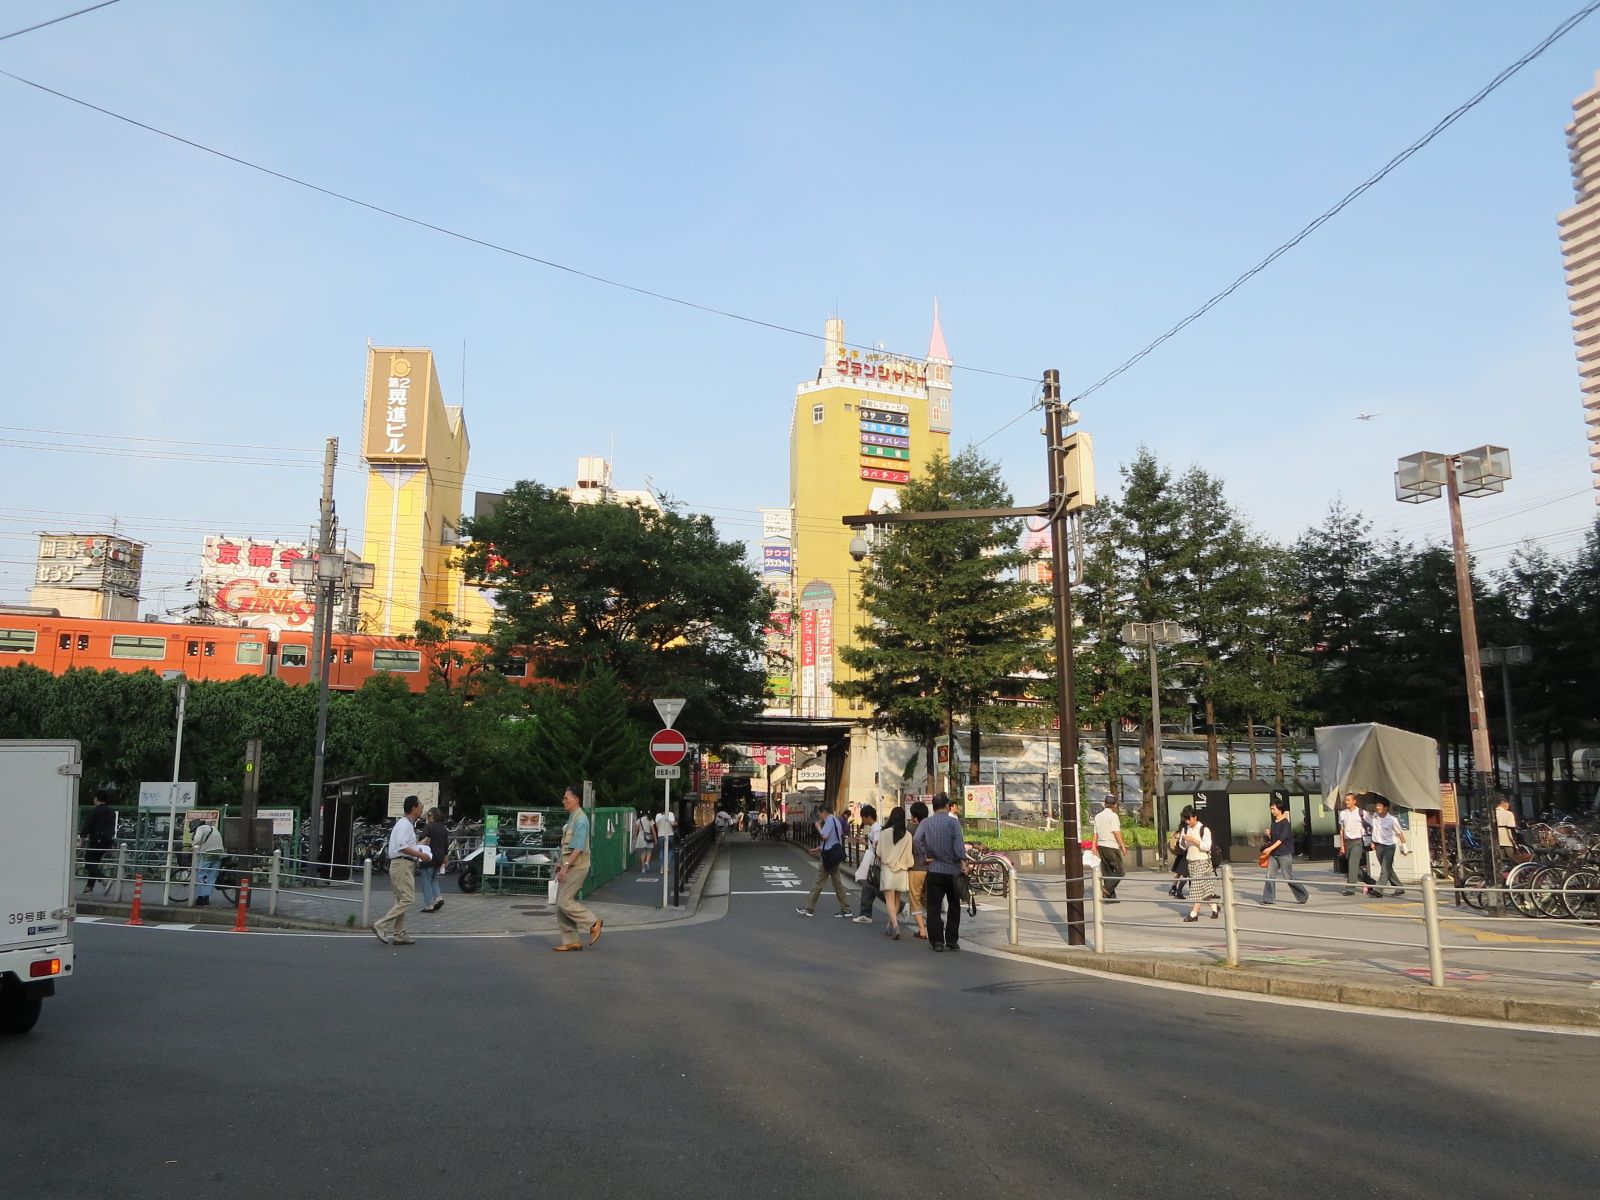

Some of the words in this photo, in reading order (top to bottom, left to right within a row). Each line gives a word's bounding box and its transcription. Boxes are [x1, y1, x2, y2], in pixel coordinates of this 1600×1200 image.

[869, 412, 907, 423] サウナ
[870, 424, 907, 435] カラオケ
[869, 435, 908, 445] キャバレー
[870, 471, 908, 481] パチンコ
[765, 549, 790, 557] サウナ
[267, 572, 279, 583] &
[819, 618, 831, 654] カラオケ
[8, 910, 47, 925] 39号車
